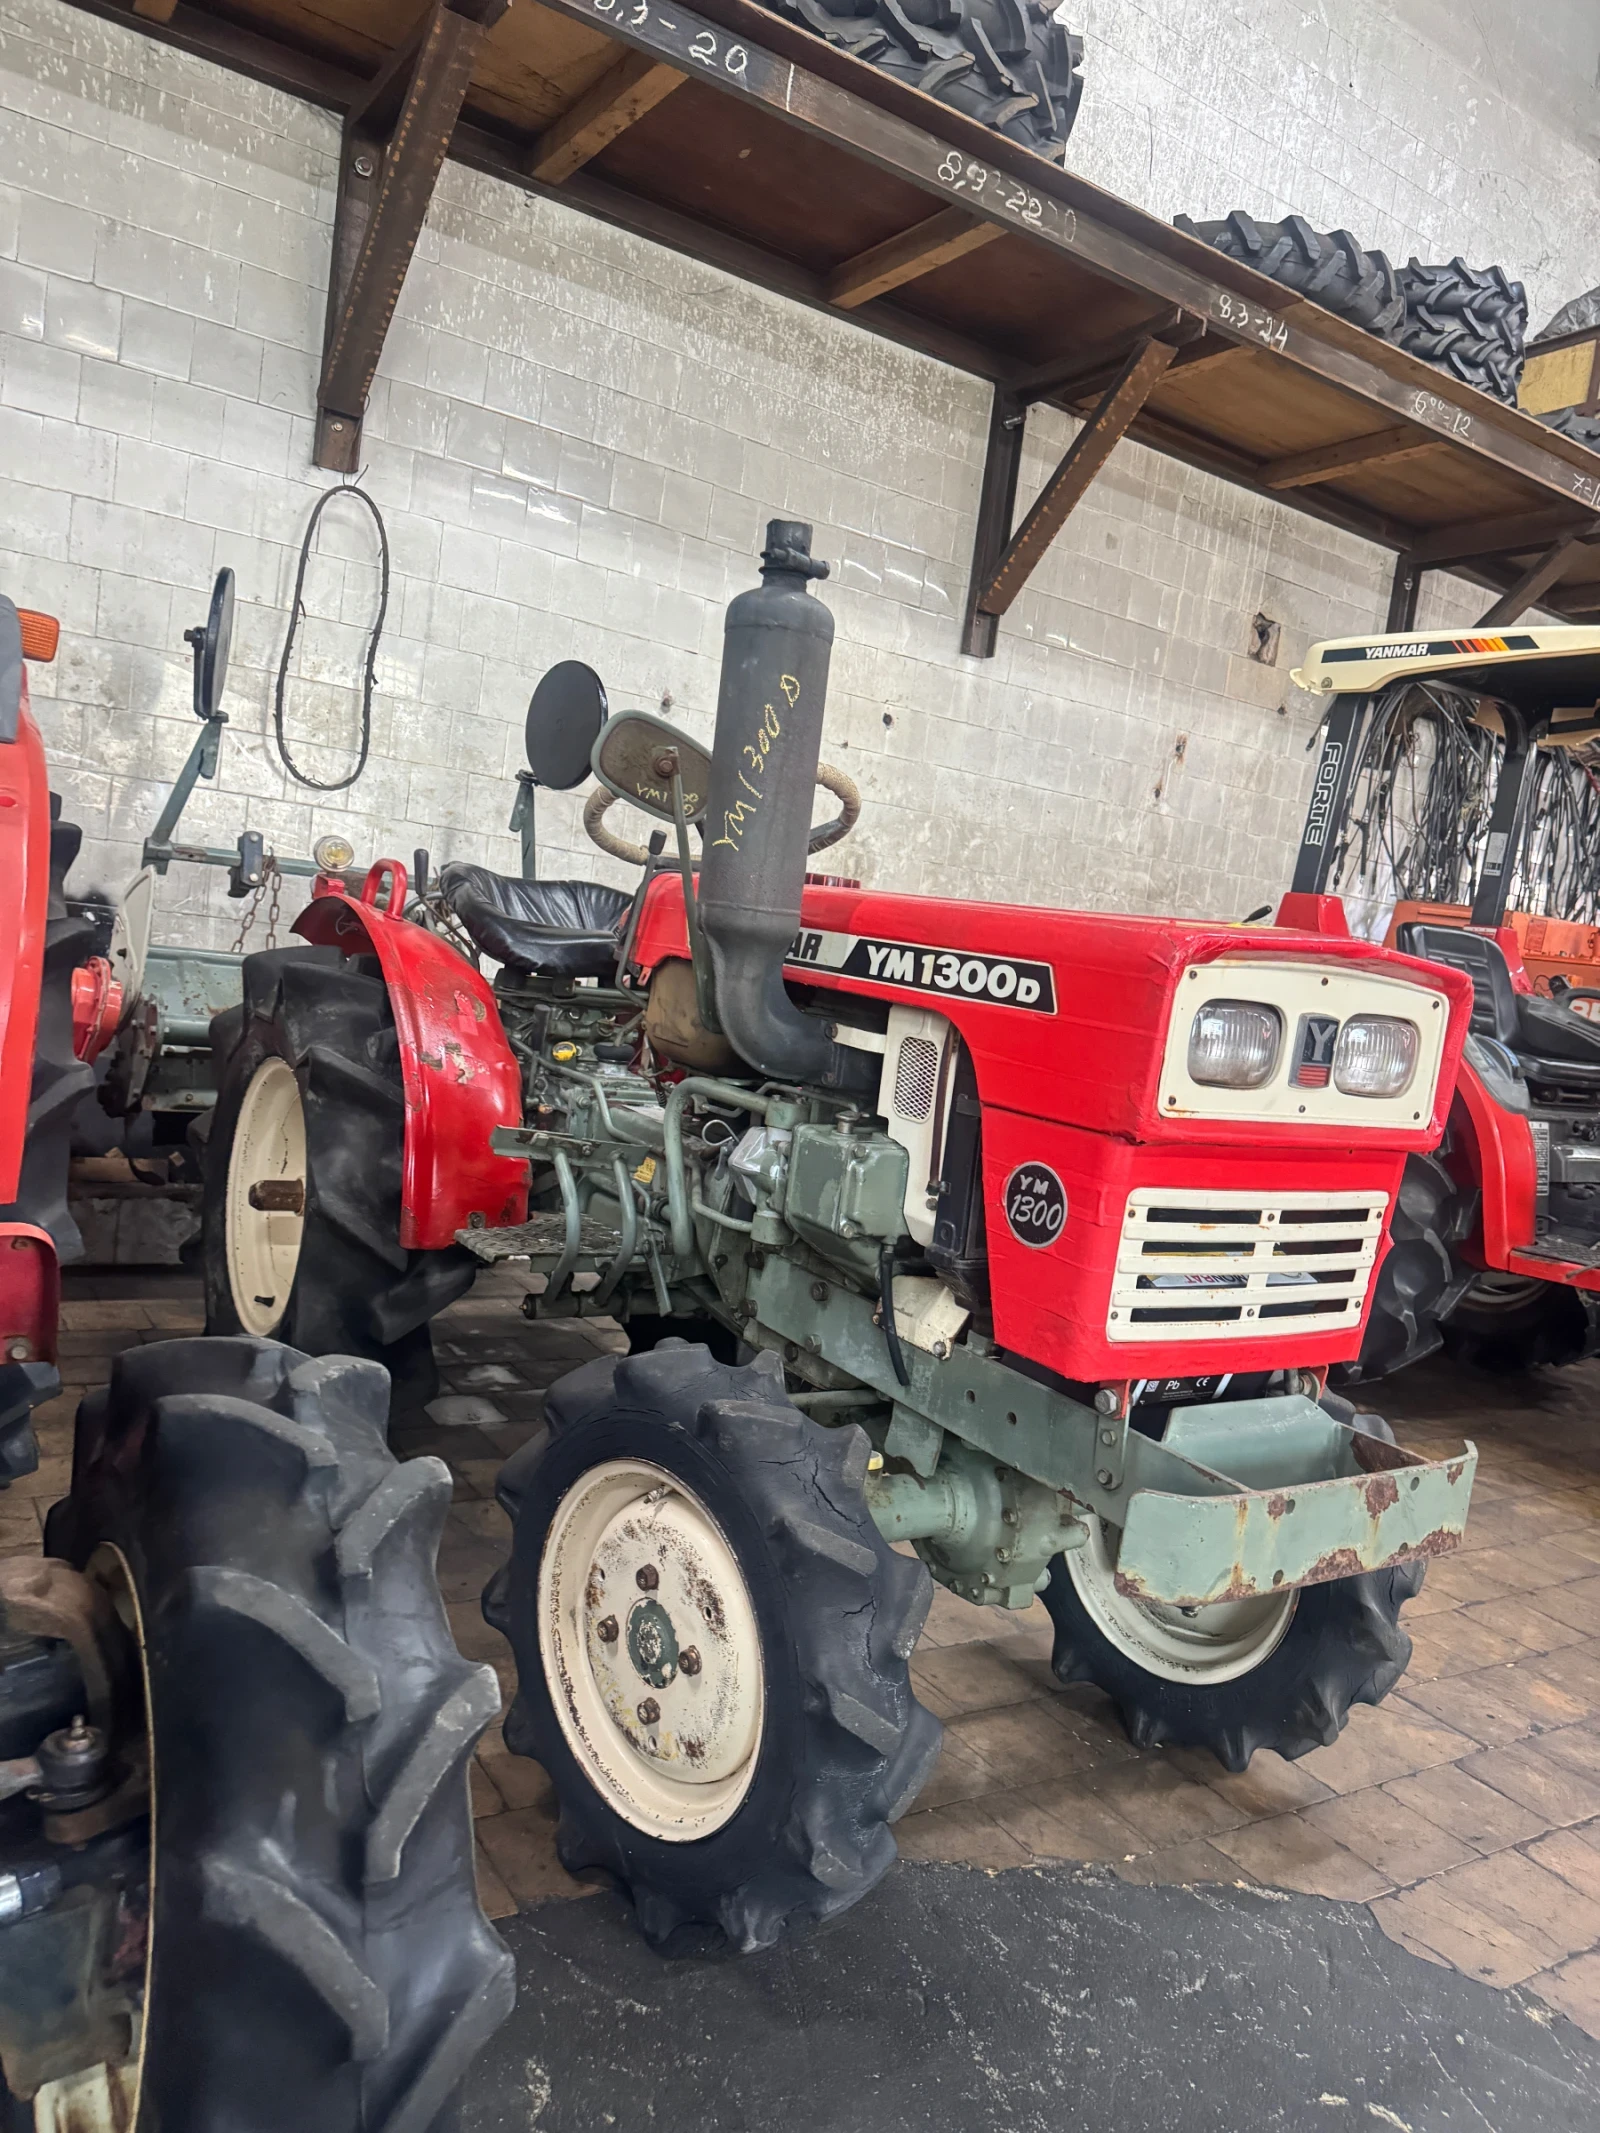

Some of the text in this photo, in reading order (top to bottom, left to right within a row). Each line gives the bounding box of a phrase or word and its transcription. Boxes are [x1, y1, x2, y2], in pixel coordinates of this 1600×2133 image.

[1365, 643, 1429, 660] YANMAR
[1305, 742, 1343, 846] FORTE
[1010, 1194, 1063, 1231] 1300
[1165, 1380, 1181, 1391] Pb
